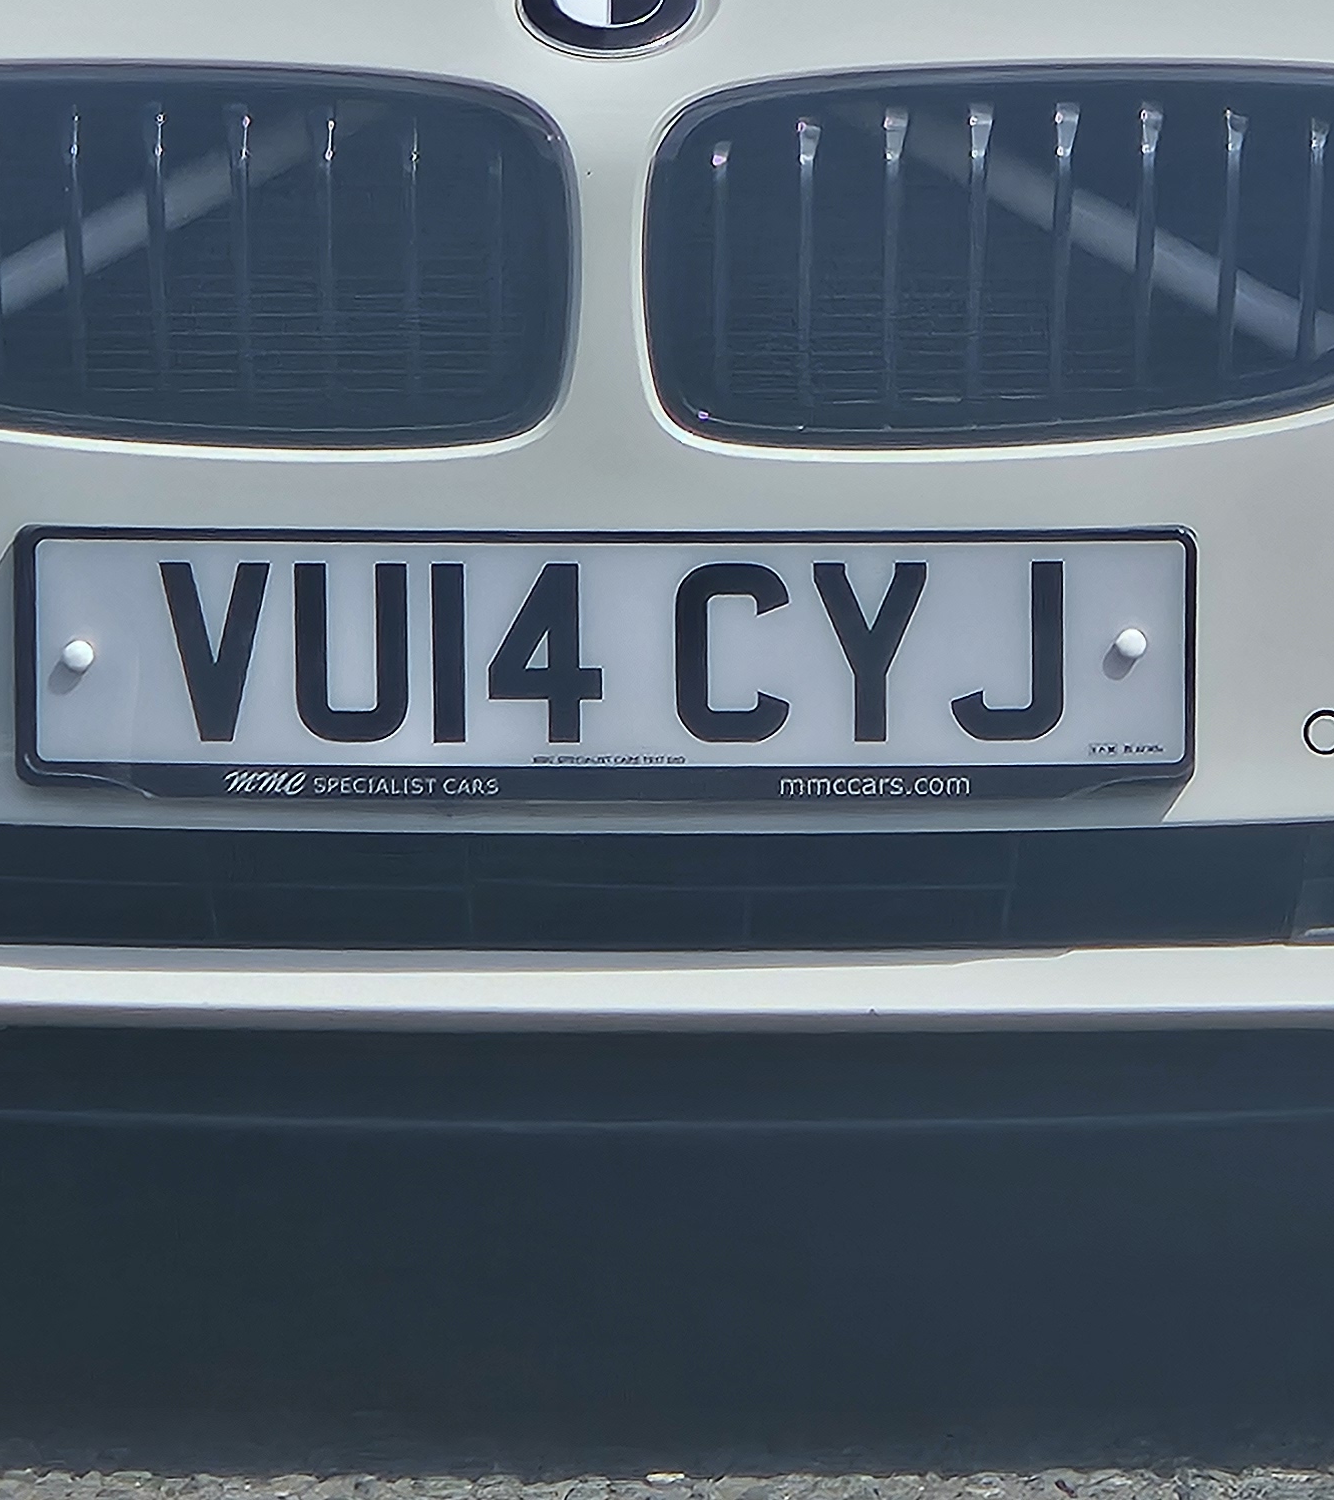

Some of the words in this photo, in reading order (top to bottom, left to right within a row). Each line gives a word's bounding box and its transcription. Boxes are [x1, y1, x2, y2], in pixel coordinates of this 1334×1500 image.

[158, 560, 603, 744] VU14
[674, 558, 1065, 744] CYJ
[223, 770, 307, 796] MMC
[313, 776, 436, 795] SPECIALIST
[442, 777, 500, 795] CARS
[779, 775, 971, 796] mmccars.com
